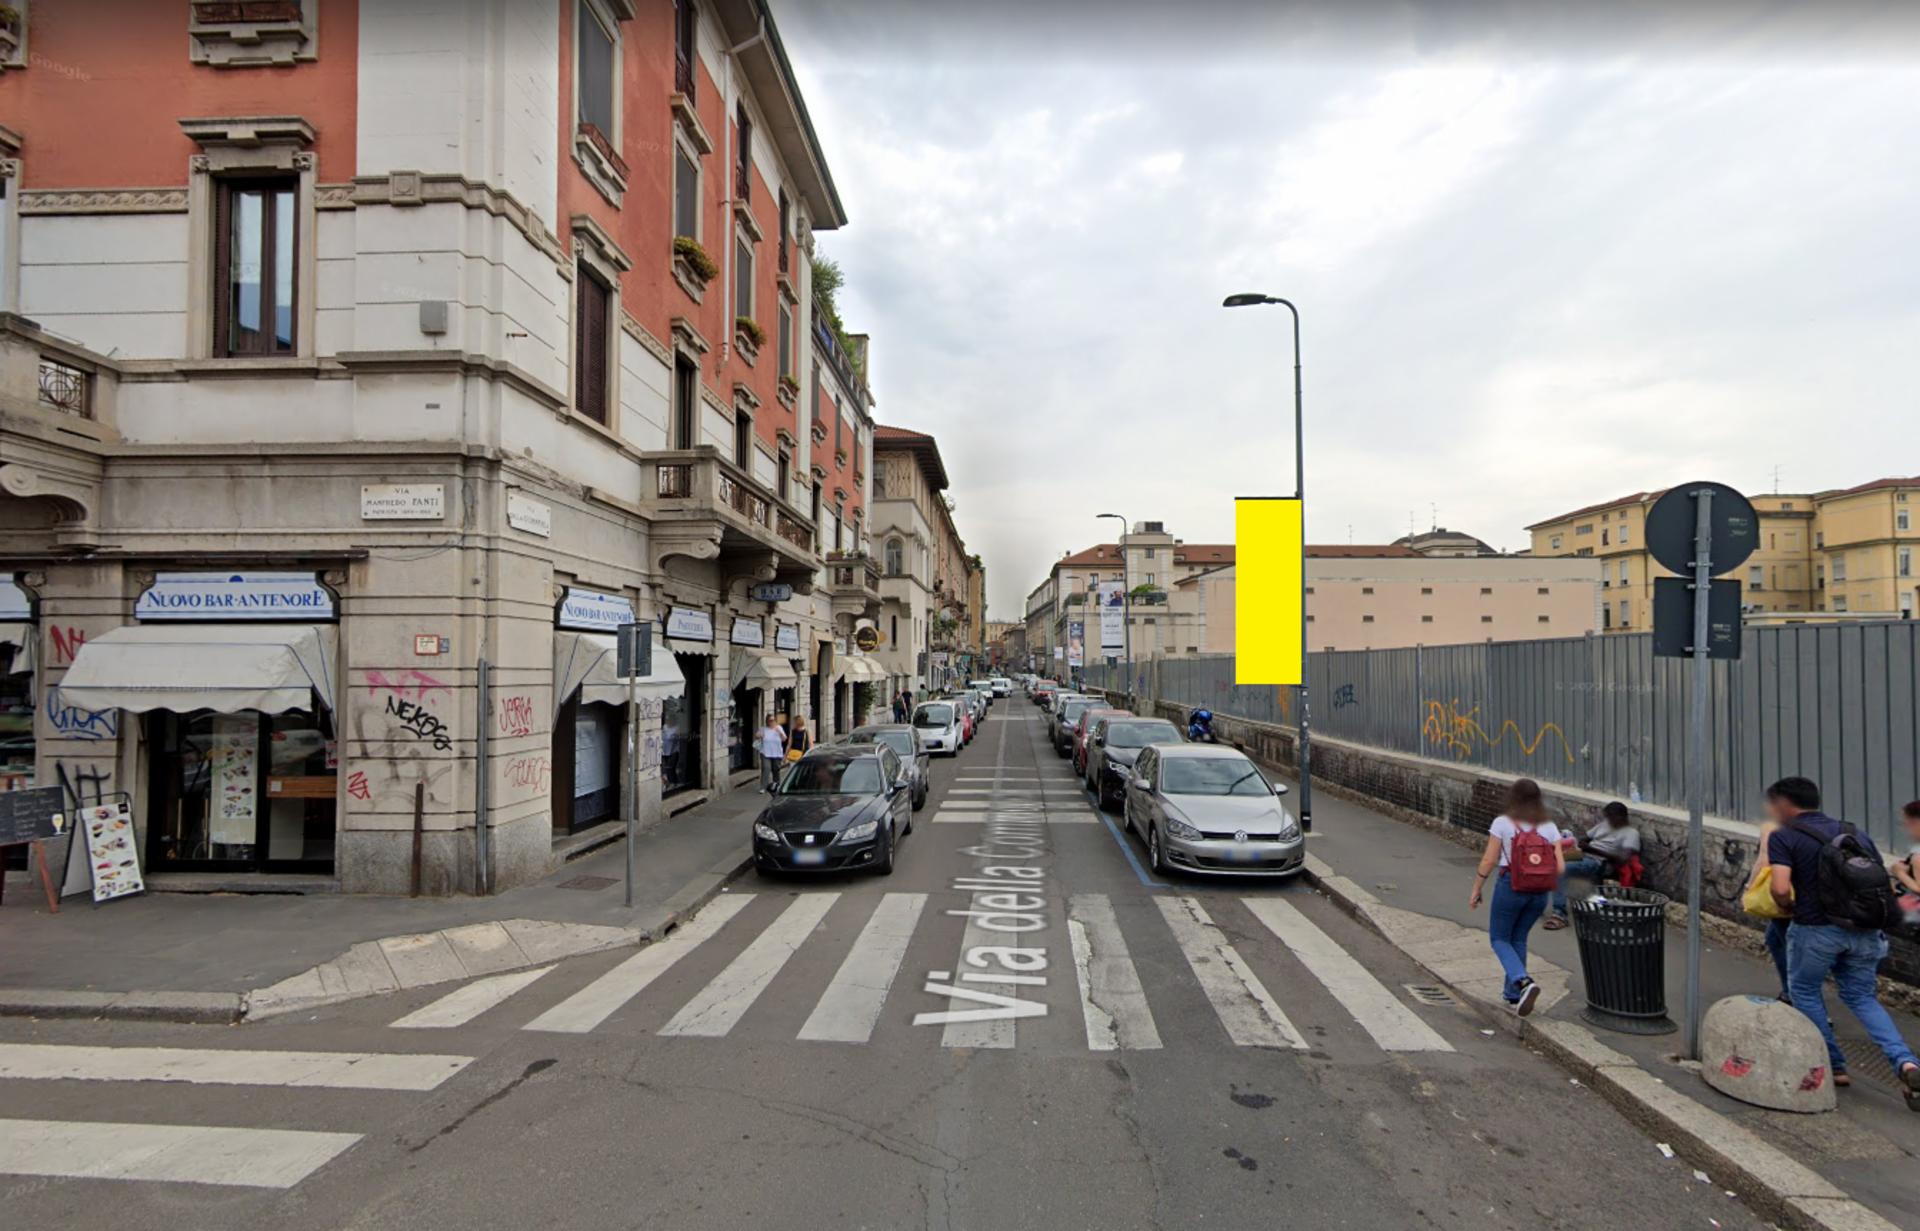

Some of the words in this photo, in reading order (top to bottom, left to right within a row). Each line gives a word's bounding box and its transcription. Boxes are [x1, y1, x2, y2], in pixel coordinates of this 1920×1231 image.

[394, 487, 410, 495] VIA
[412, 498, 439, 506] FANTI
[148, 591, 201, 607] NUOVO
